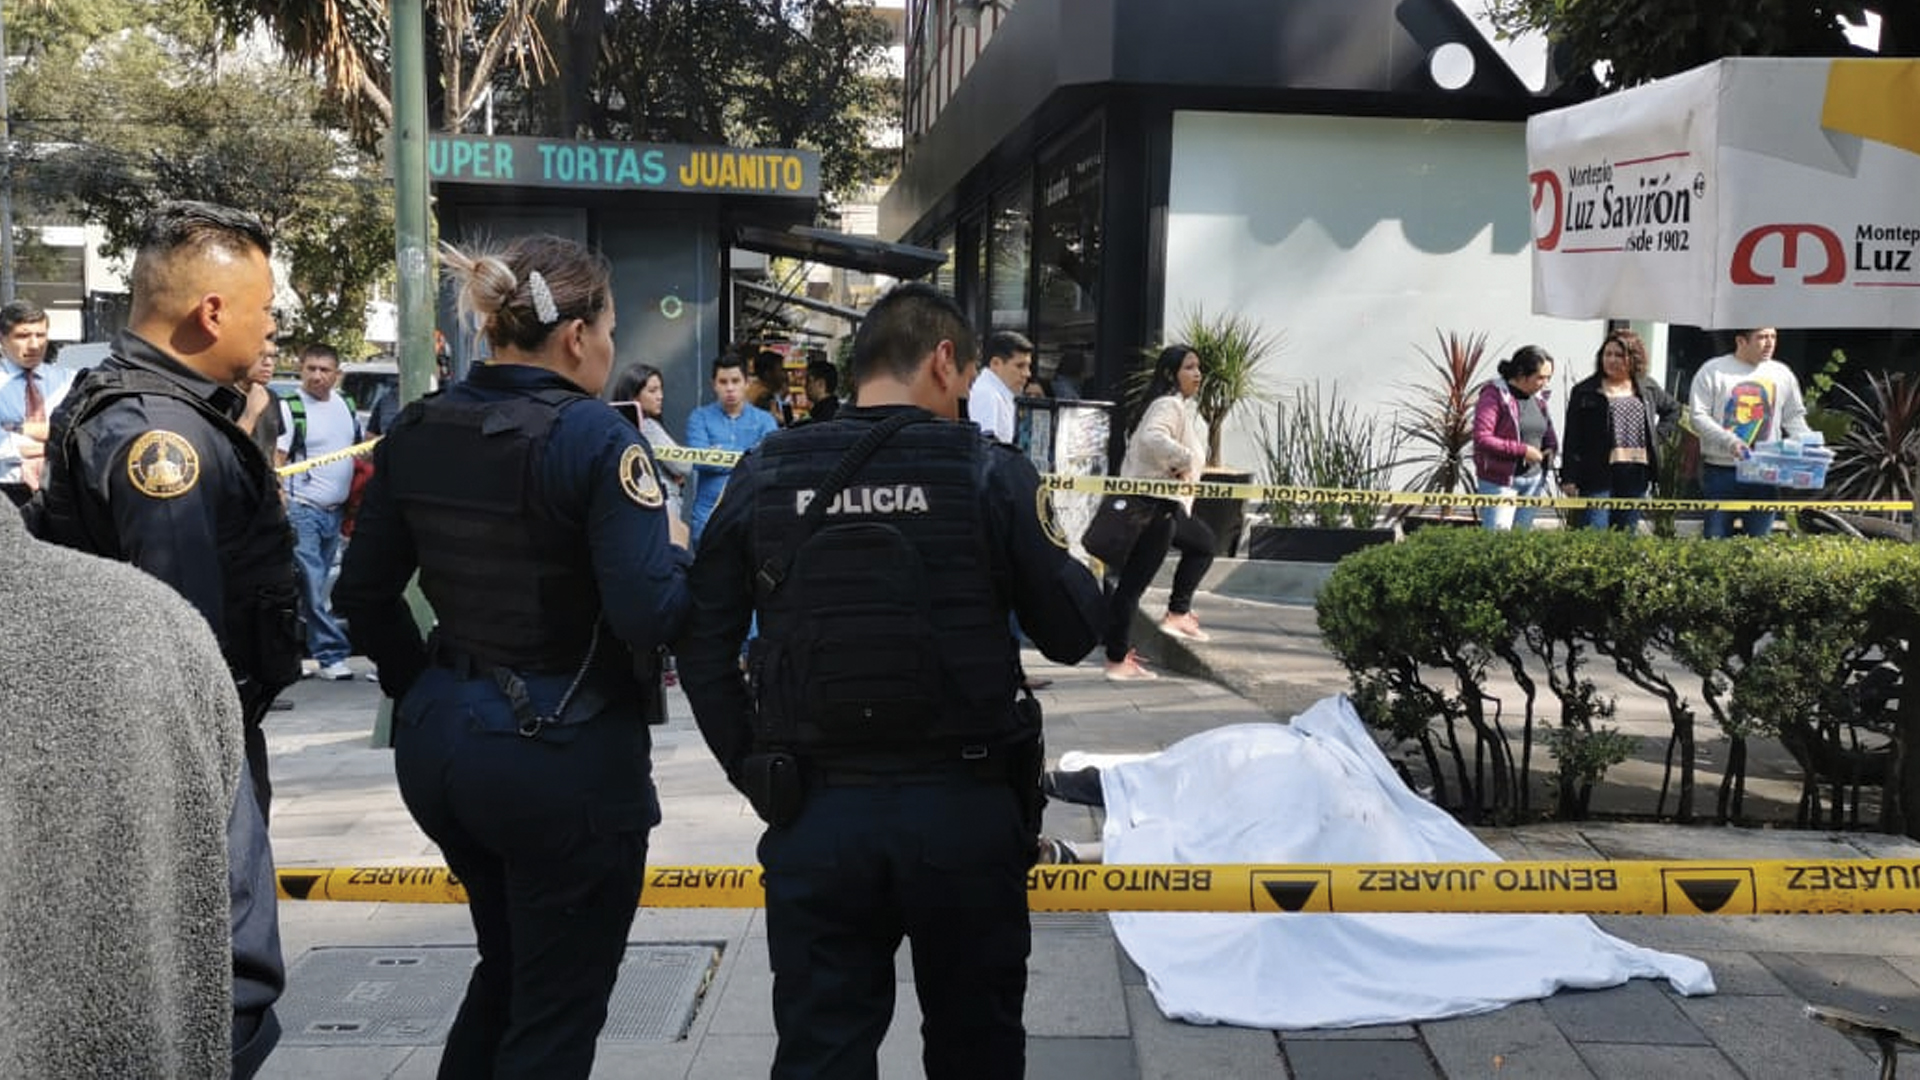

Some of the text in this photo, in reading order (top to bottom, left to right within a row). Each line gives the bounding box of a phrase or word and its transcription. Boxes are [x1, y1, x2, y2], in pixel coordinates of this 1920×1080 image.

[429, 139, 803, 191] UPER TORTAS JUANITO
[1565, 191, 1594, 232] Luz
[1657, 229, 1689, 251] 1902
[1855, 224, 1920, 246] Montep
[1855, 241, 1911, 271] Luz
[657, 448, 738, 464] ECAUCI
[1104, 479, 1233, 498] PRECAUCION
[348, 867, 446, 885] JUAREZ
[651, 868, 753, 888] JUAREZ
[1027, 869, 1212, 891] BENITO JUAR
[1358, 869, 1618, 891] BENITO JUAREZ
